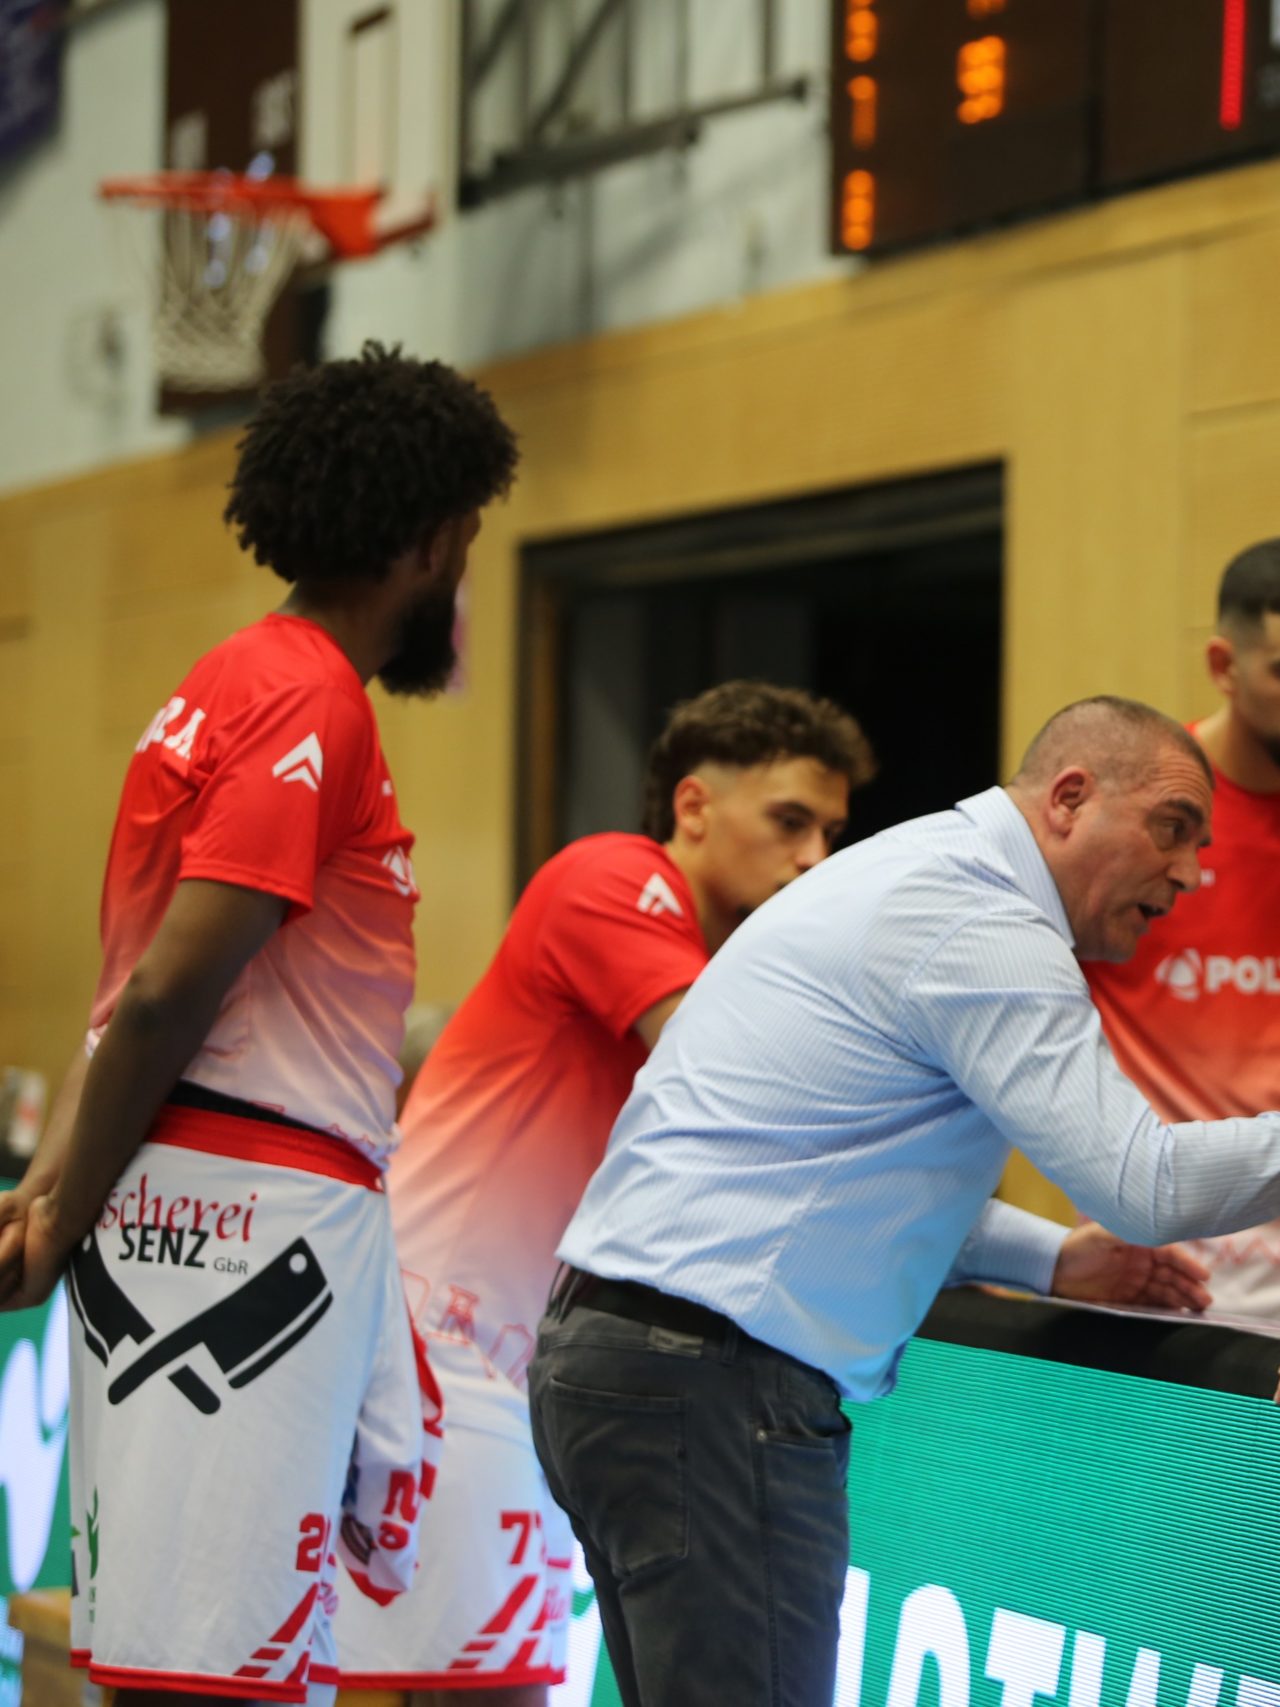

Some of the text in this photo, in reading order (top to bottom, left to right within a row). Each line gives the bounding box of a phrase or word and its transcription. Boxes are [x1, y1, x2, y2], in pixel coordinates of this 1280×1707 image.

[98, 1172, 258, 1242] scherei
[118, 1222, 249, 1275] SENZ GbR
